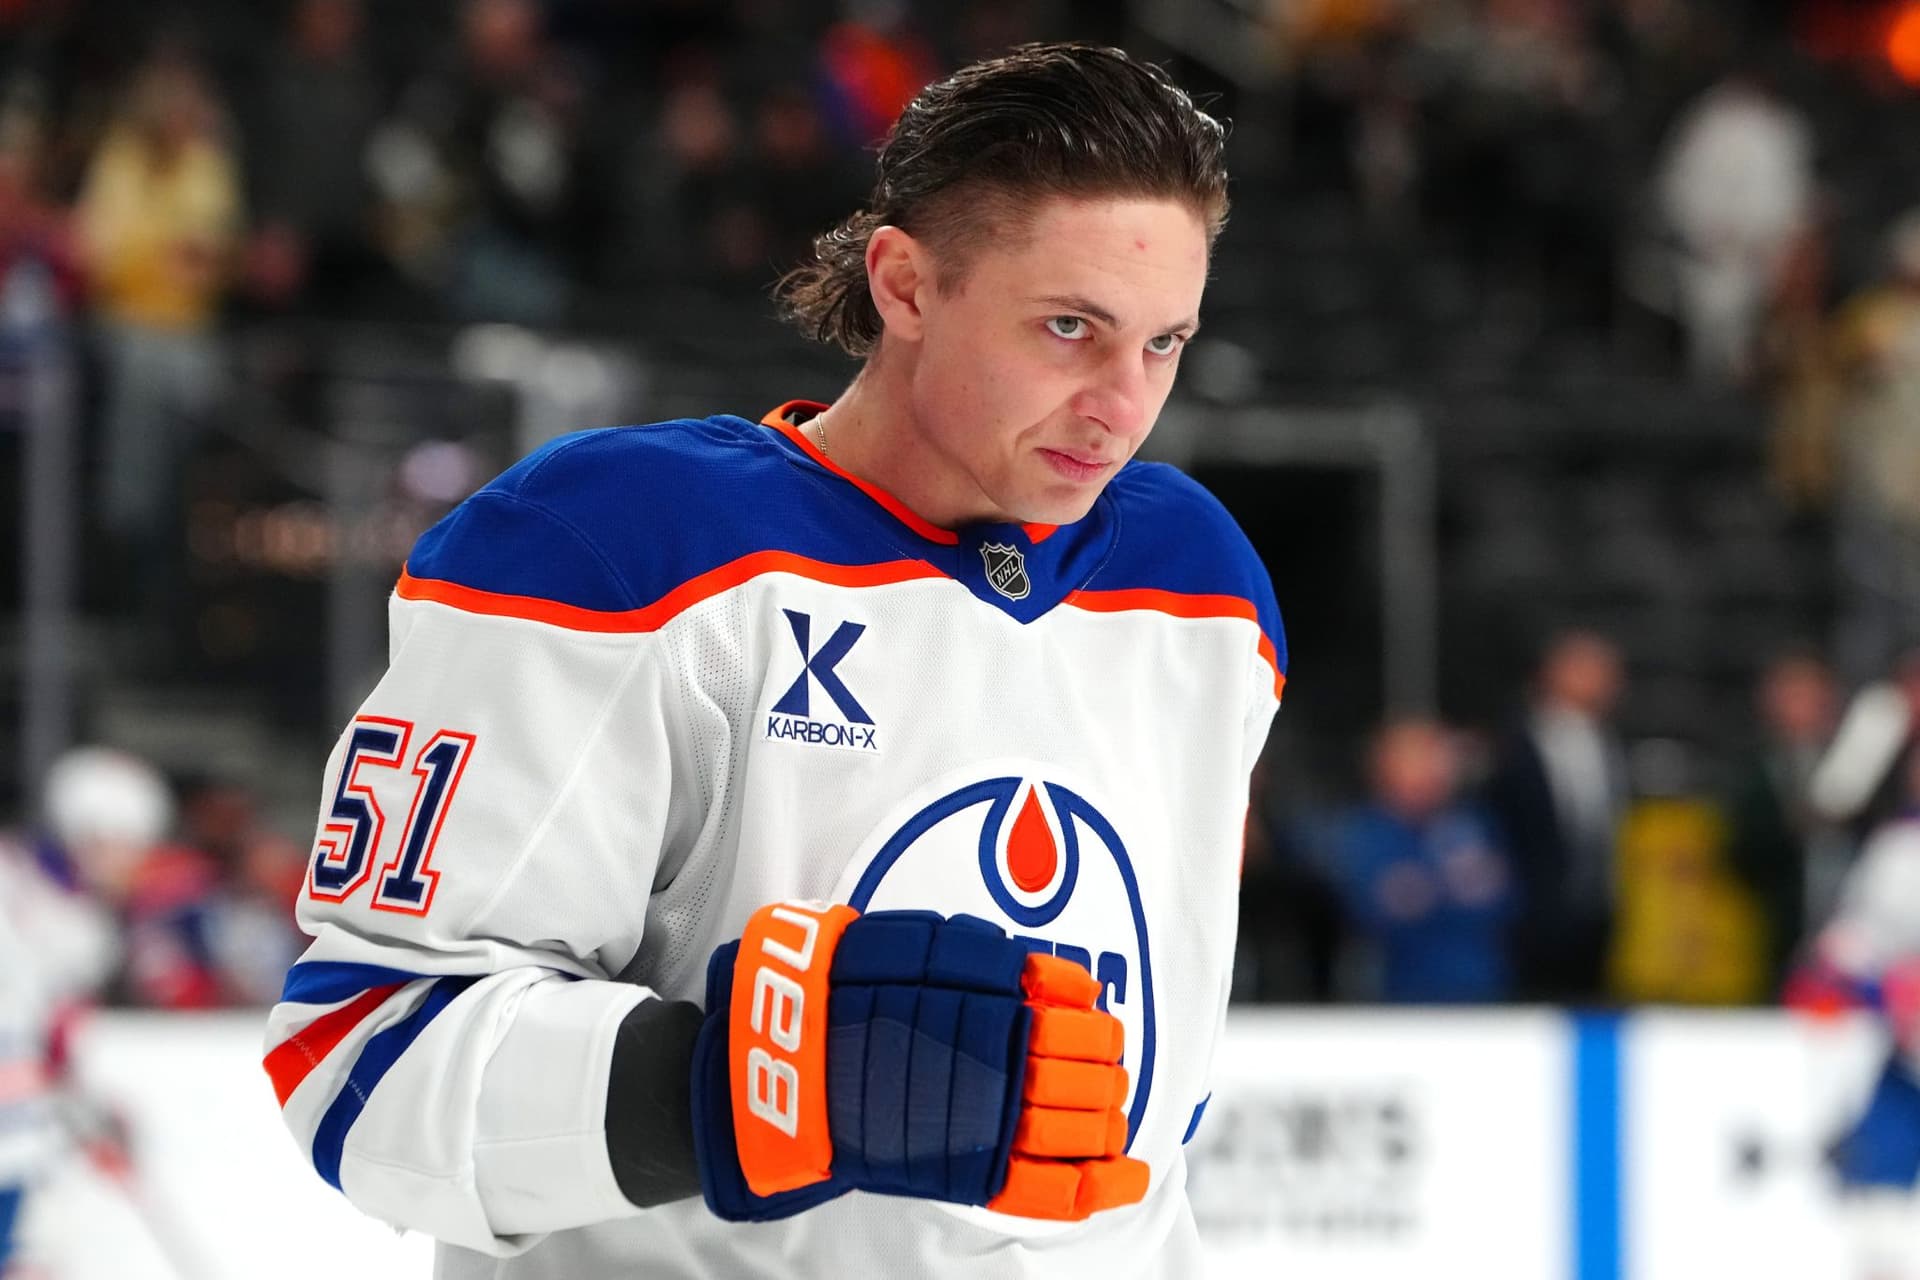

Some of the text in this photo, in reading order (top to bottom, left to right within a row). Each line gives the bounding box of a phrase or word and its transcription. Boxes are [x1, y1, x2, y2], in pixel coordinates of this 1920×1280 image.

[995, 560, 1018, 587] NHL
[767, 716, 877, 750] KARBON-X
[309, 714, 477, 918] 51
